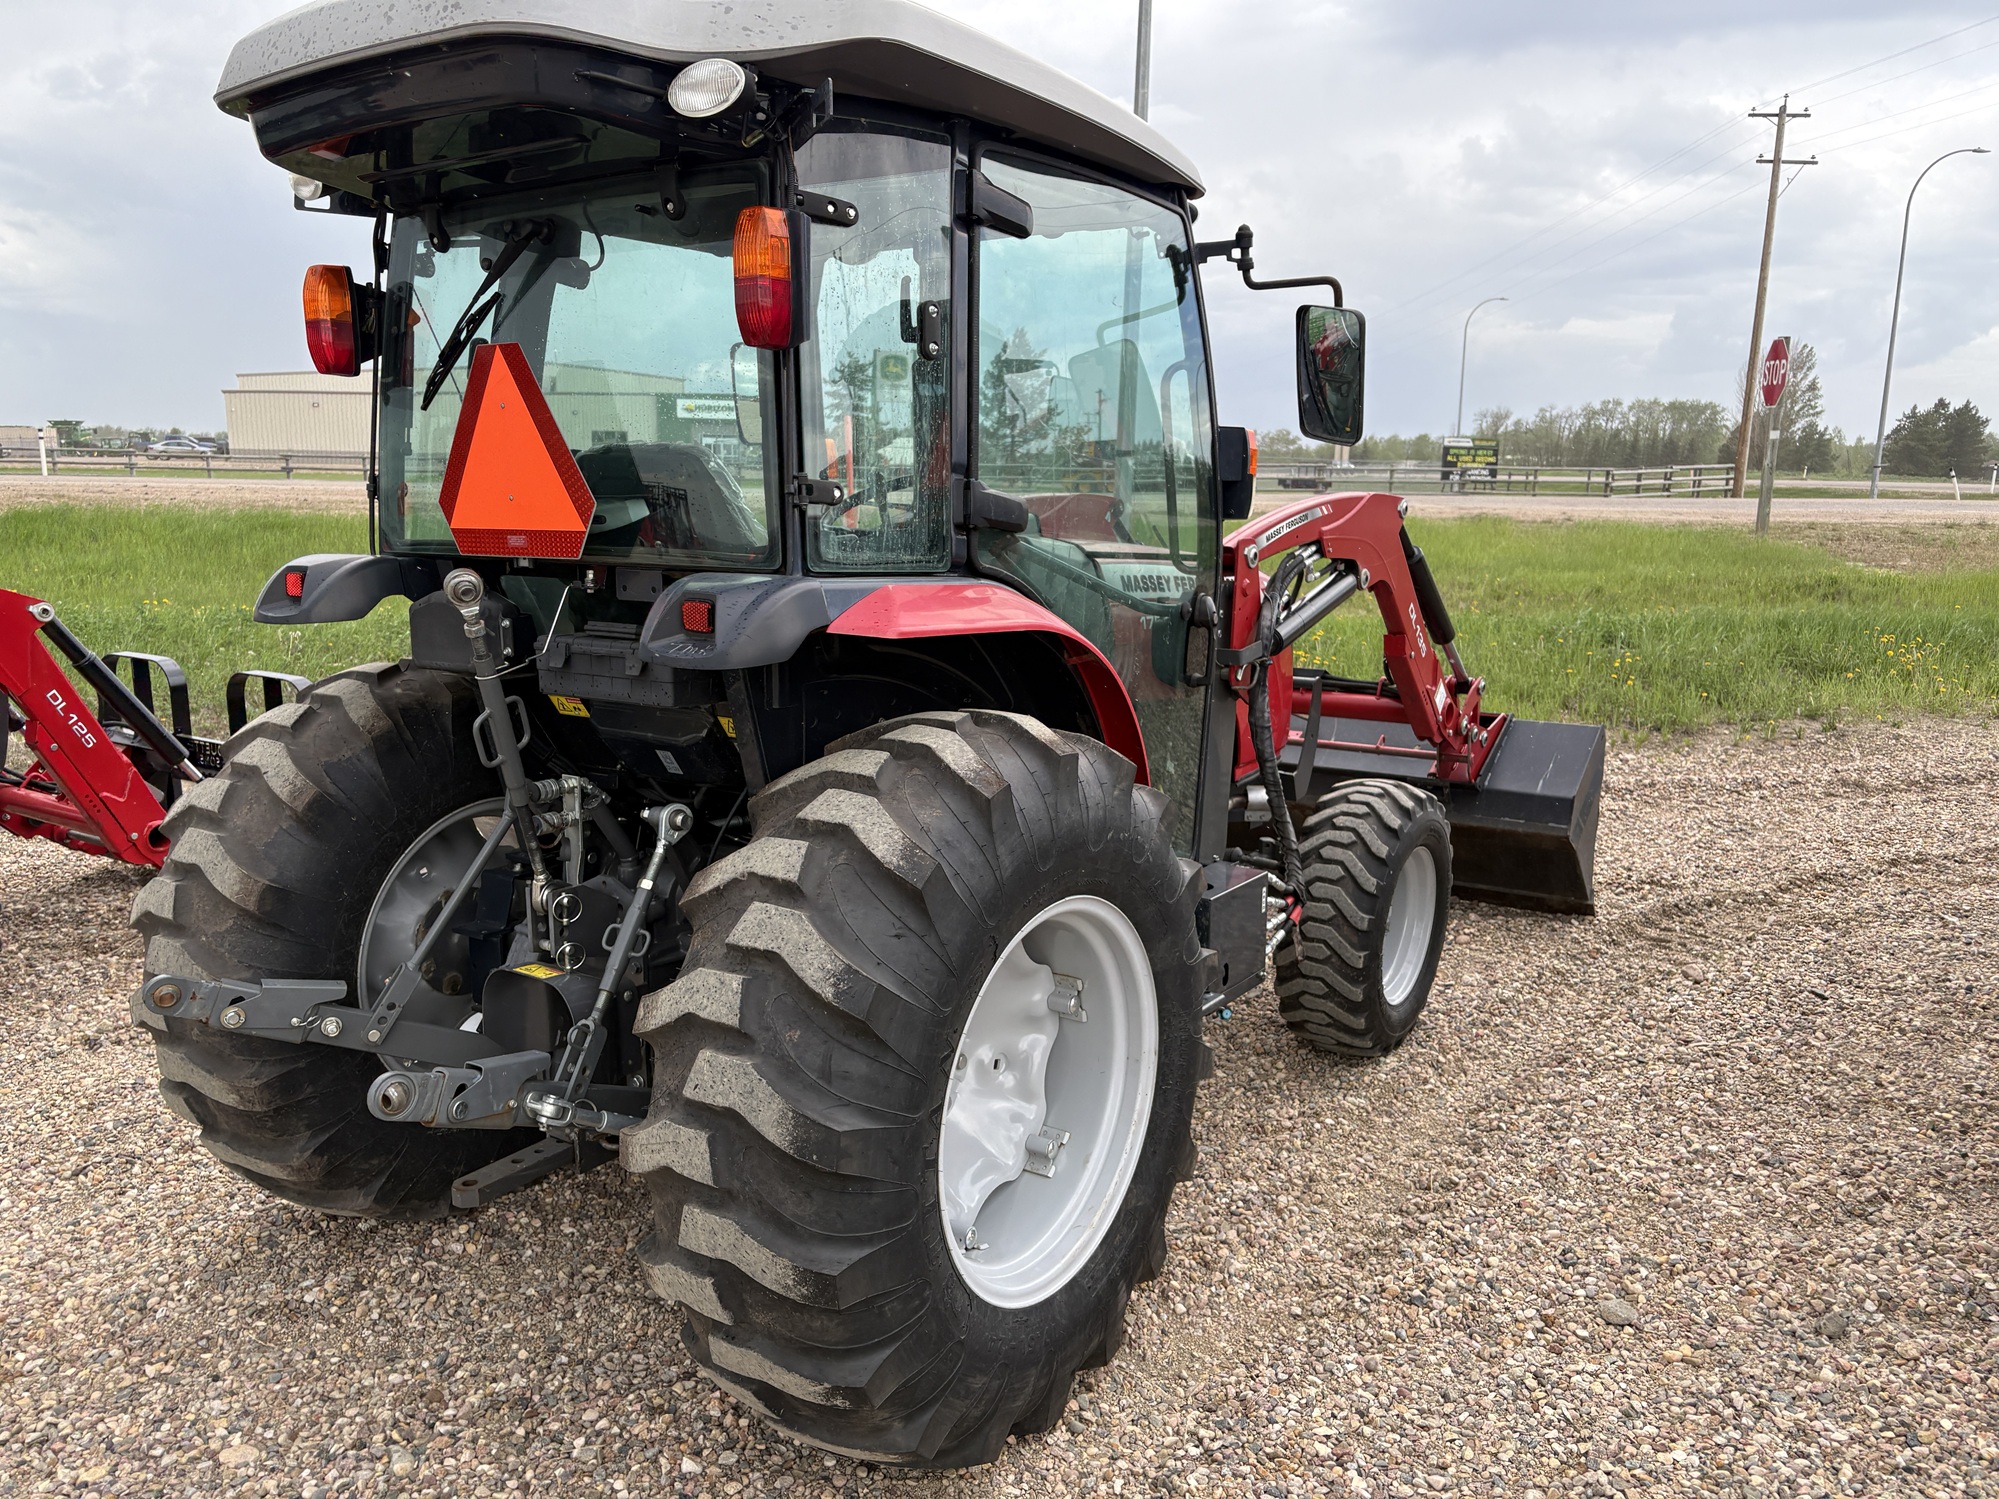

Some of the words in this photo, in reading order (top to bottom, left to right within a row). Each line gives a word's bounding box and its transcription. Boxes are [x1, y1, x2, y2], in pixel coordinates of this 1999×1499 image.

[1763, 359, 1787, 387] STOP
[1265, 525, 1285, 543] MASSEY
[1285, 512, 1309, 531] FERGUSON
[1120, 575, 1171, 593] MASSEY
[1173, 575, 1197, 593] FER
[46, 689, 67, 717] DL
[68, 713, 97, 749] 125
